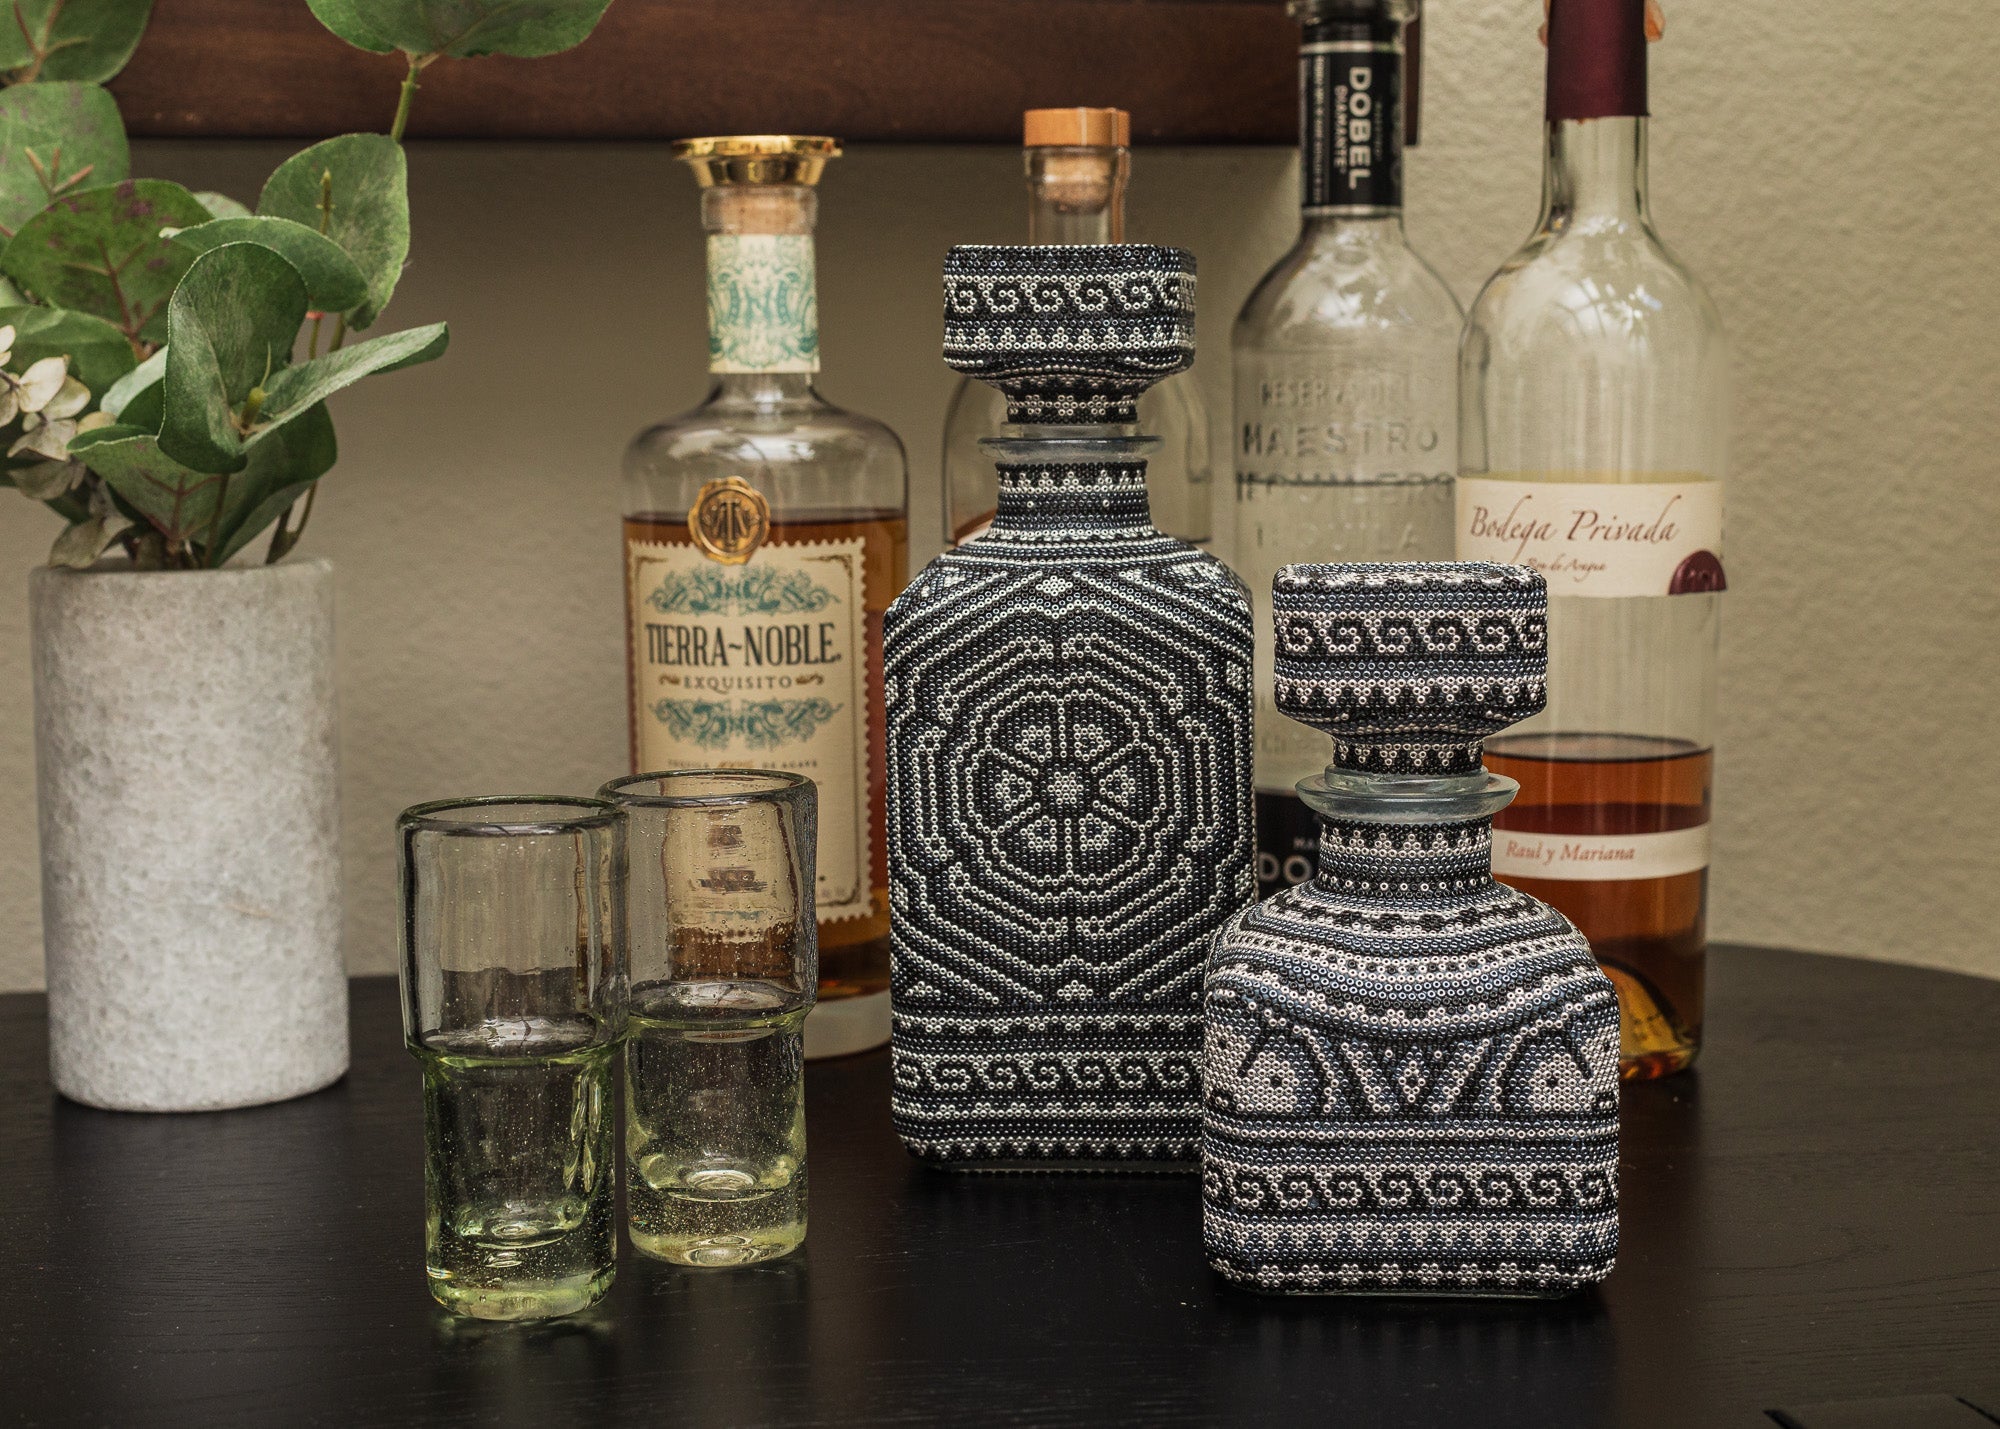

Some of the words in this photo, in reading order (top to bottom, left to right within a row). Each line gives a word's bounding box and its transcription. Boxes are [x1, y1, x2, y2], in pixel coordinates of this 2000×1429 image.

[1349, 66, 1372, 191] DOBEL
[1242, 421, 1439, 457] MAESTRO
[1470, 494, 1557, 564] Bodega
[1566, 494, 1682, 542] Privada
[683, 674, 793, 695] EXQUISITO
[1506, 839, 1544, 859] Raul
[1542, 848, 1556, 867] y
[1560, 842, 1636, 861] Mariana
